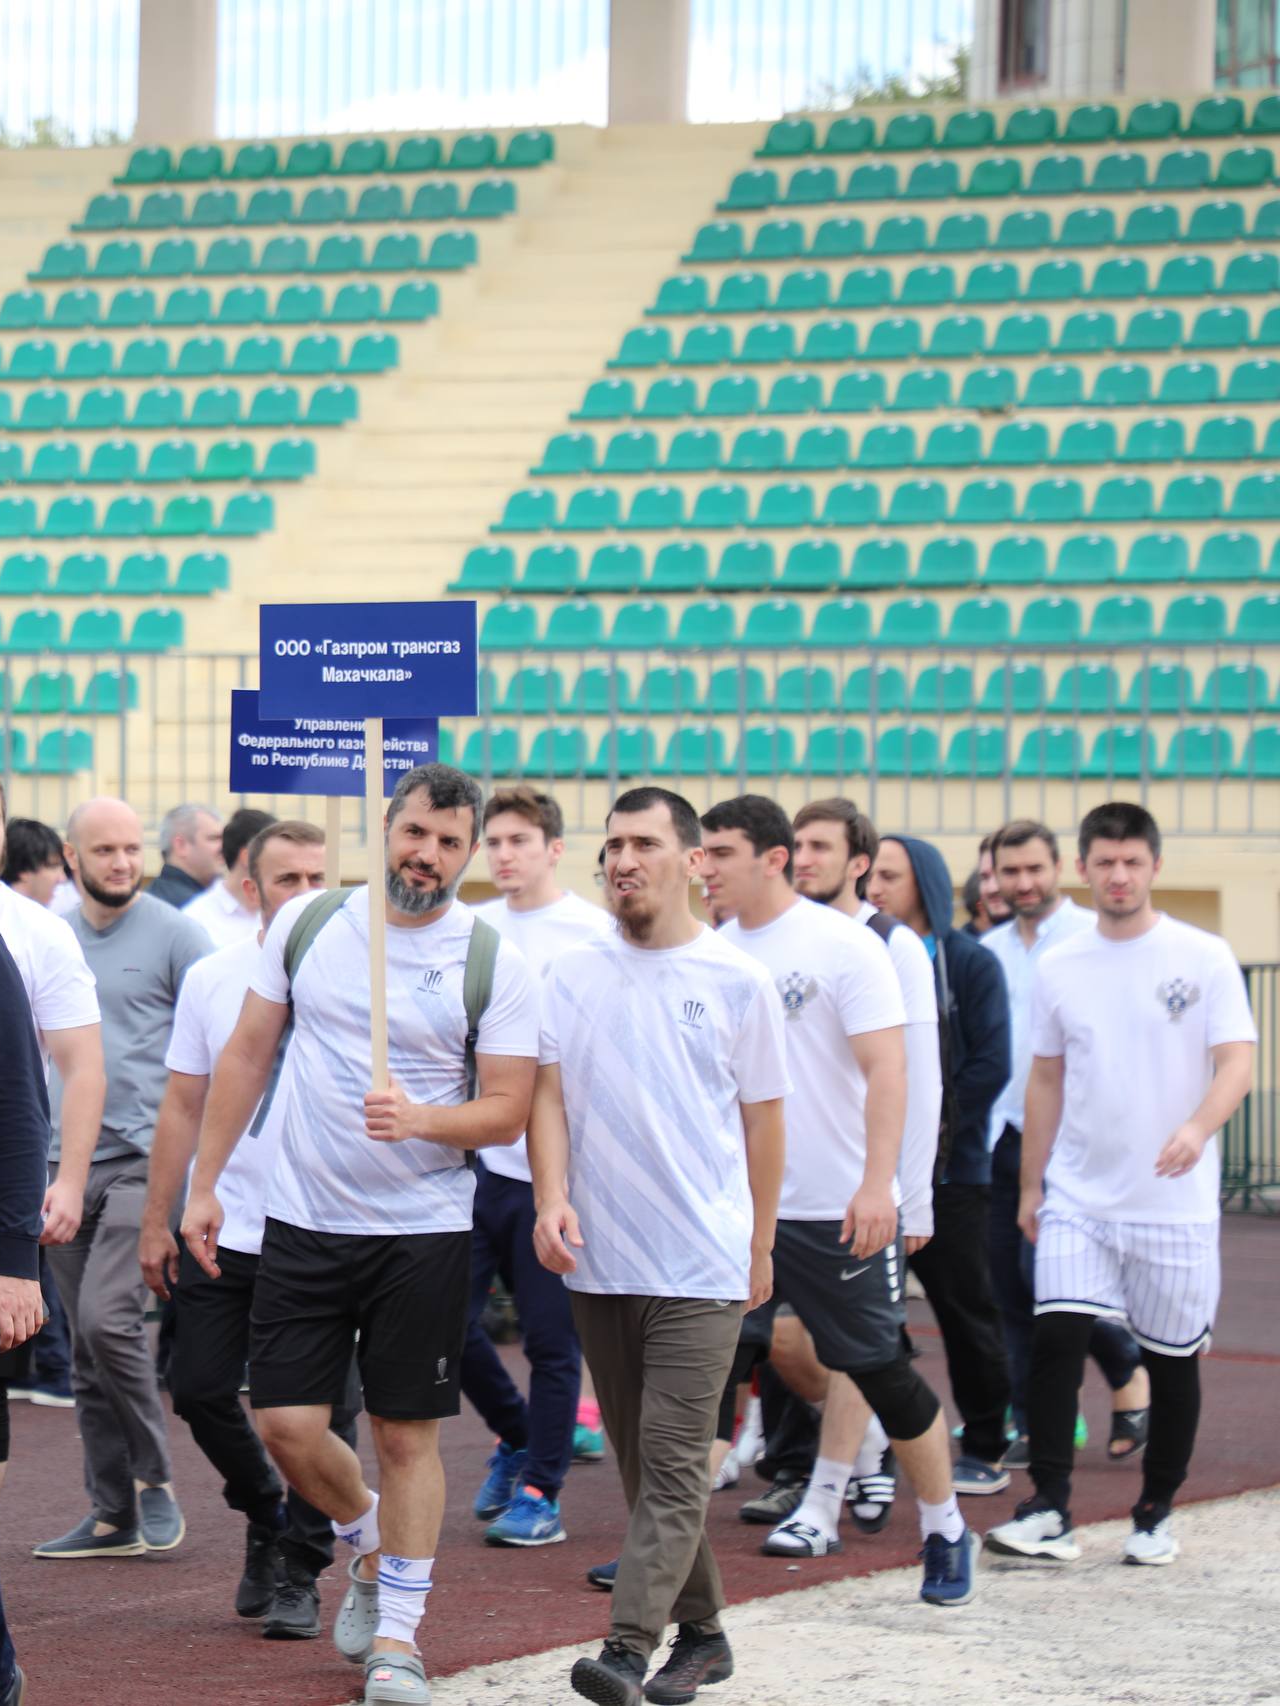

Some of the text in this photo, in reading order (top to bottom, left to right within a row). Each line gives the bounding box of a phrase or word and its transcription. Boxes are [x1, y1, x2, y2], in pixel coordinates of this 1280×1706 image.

[274, 639, 461, 658] ООО «Газпром трансгаз
[322, 666, 412, 683] Махачкала»
[294, 717, 366, 733] Управлени
[238, 733, 335, 750] Федерального
[252, 753, 269, 766] по
[271, 752, 349, 769] Республике
